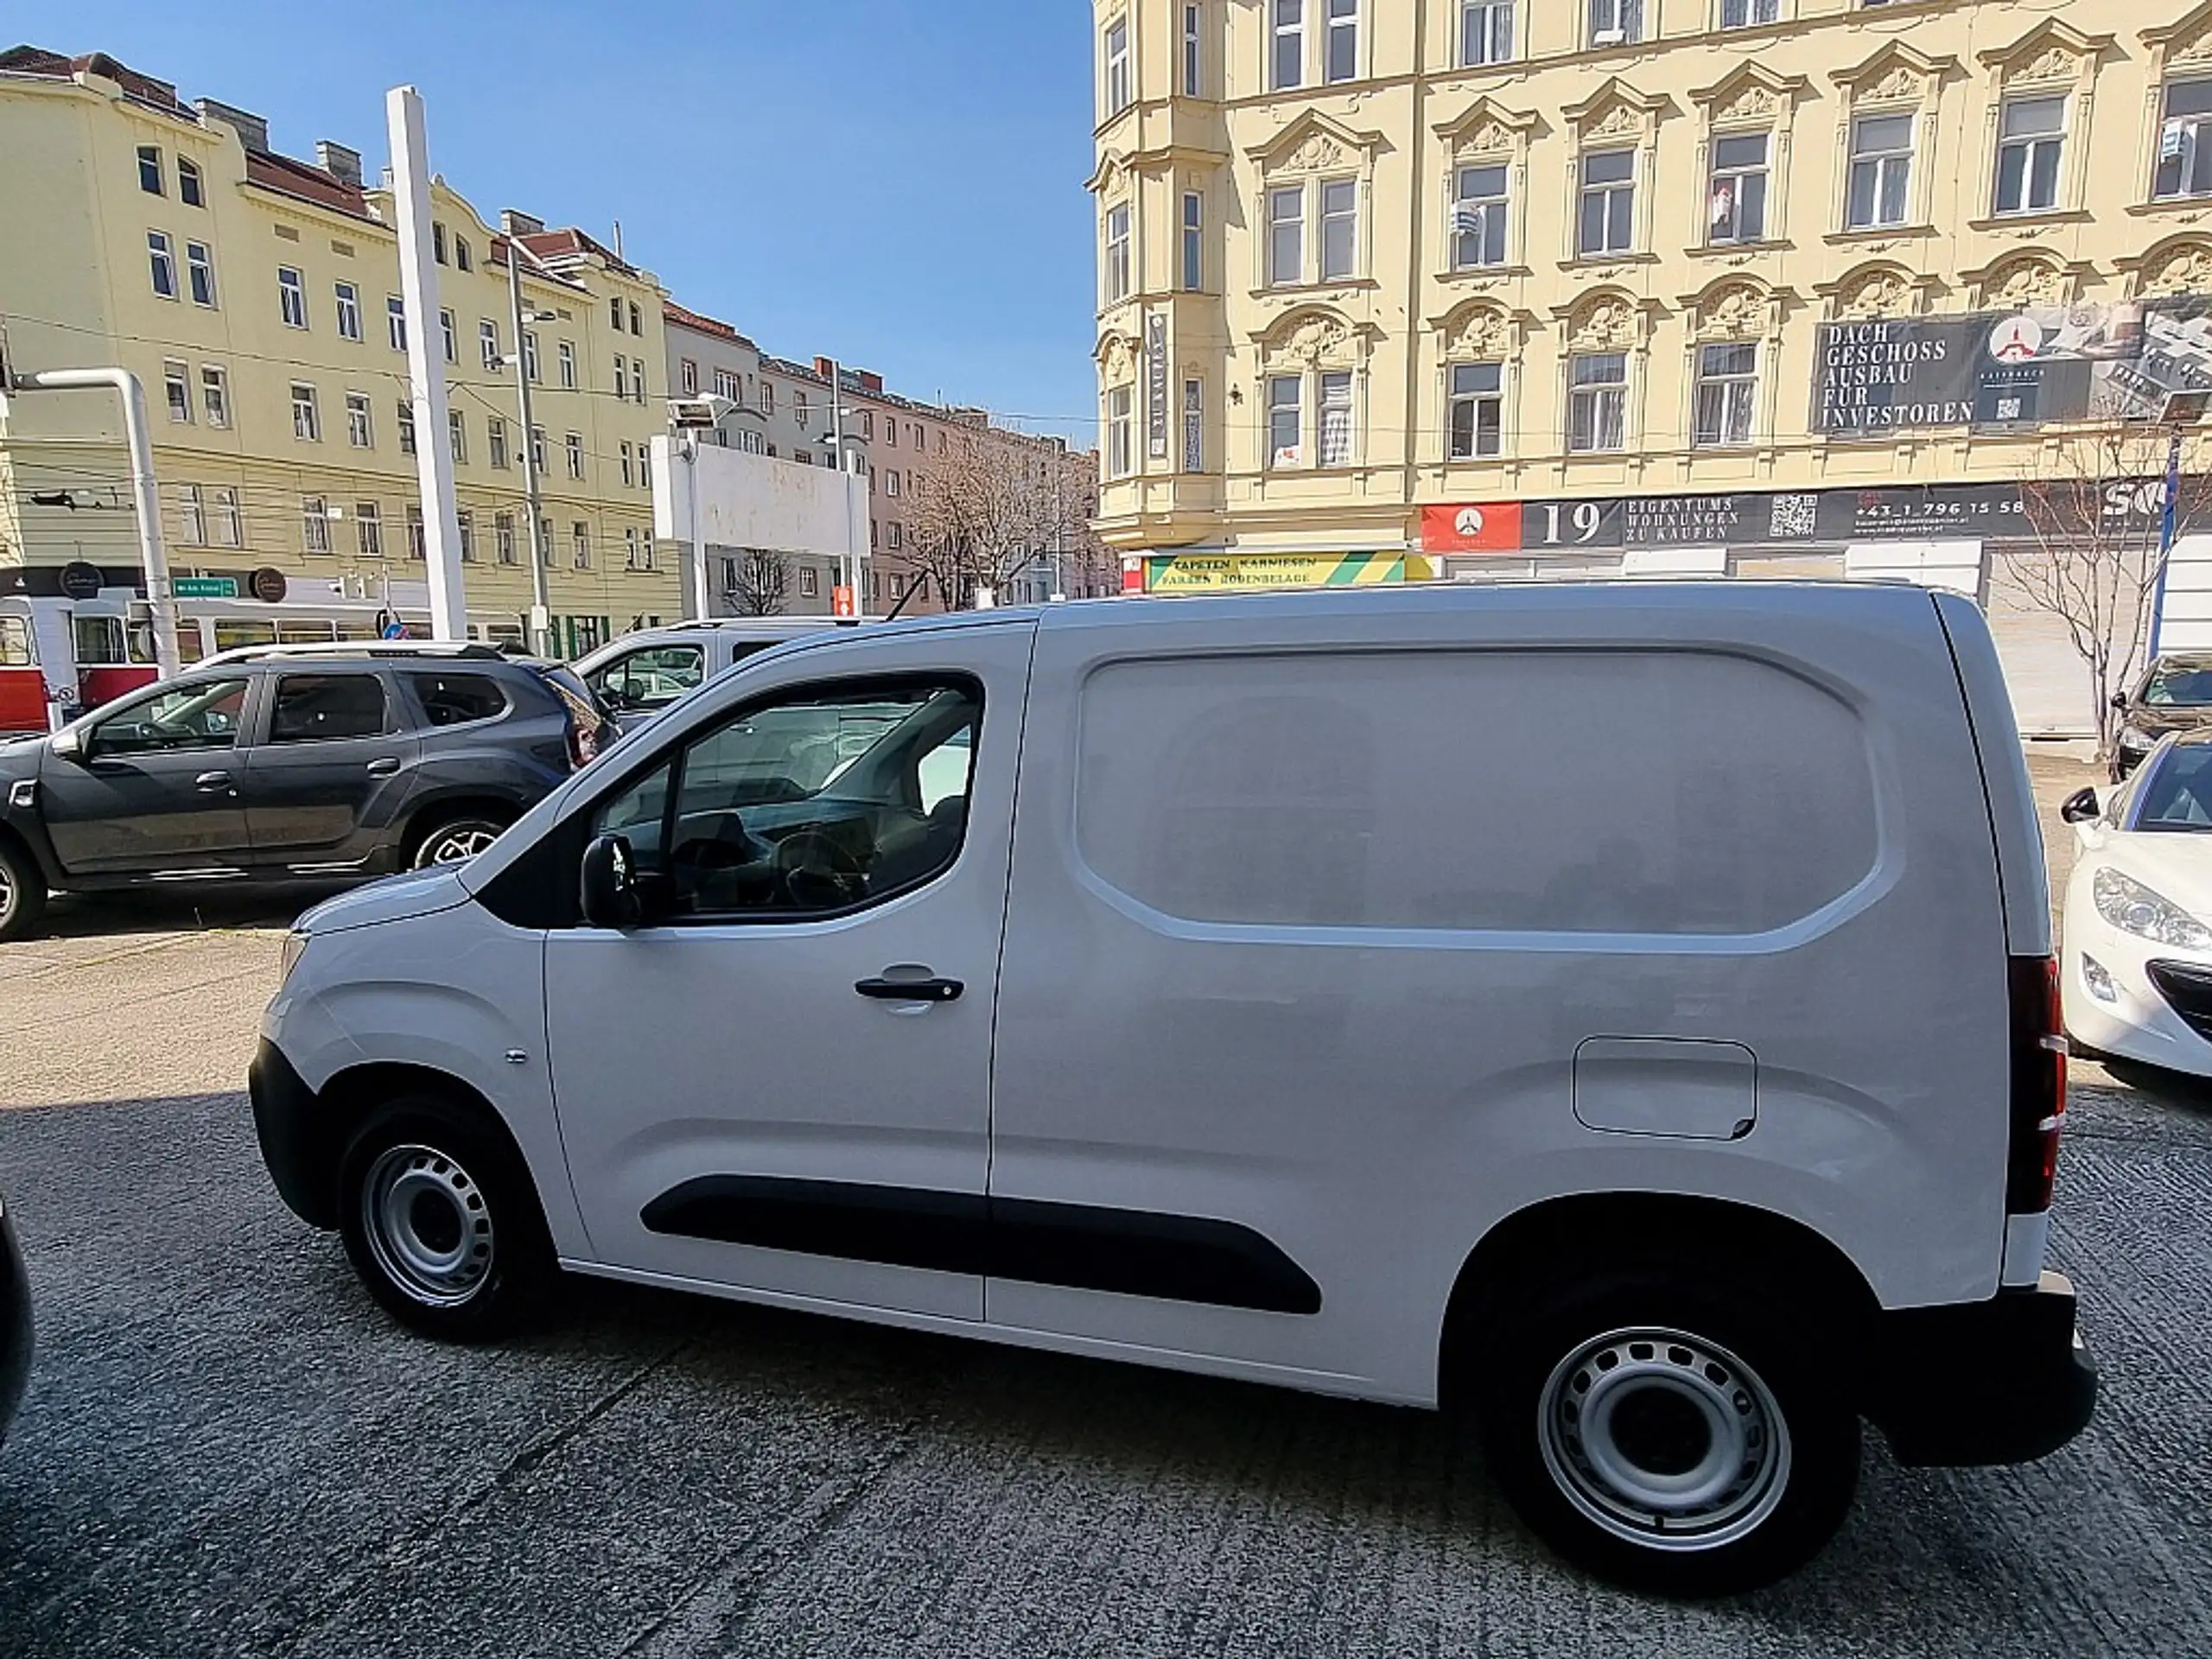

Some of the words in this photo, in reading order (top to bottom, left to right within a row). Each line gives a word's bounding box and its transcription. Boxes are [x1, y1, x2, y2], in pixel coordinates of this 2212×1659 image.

[1828, 324, 1888, 345] DACH
[1827, 340, 1947, 366] GESCHOSS
[1823, 363, 1913, 388] AUSBAU
[1821, 402, 1974, 428] INVESTOREN
[1628, 497, 1732, 513] EIGENTUMS
[1969, 502, 1990, 514] 15
[1542, 502, 1601, 544] 19
[1627, 512, 1739, 527] WOHNUNGEN
[1626, 528, 1648, 542] ZU
[1656, 525, 1726, 542] KAUFEN
[1173, 559, 1231, 571] TAPETEN
